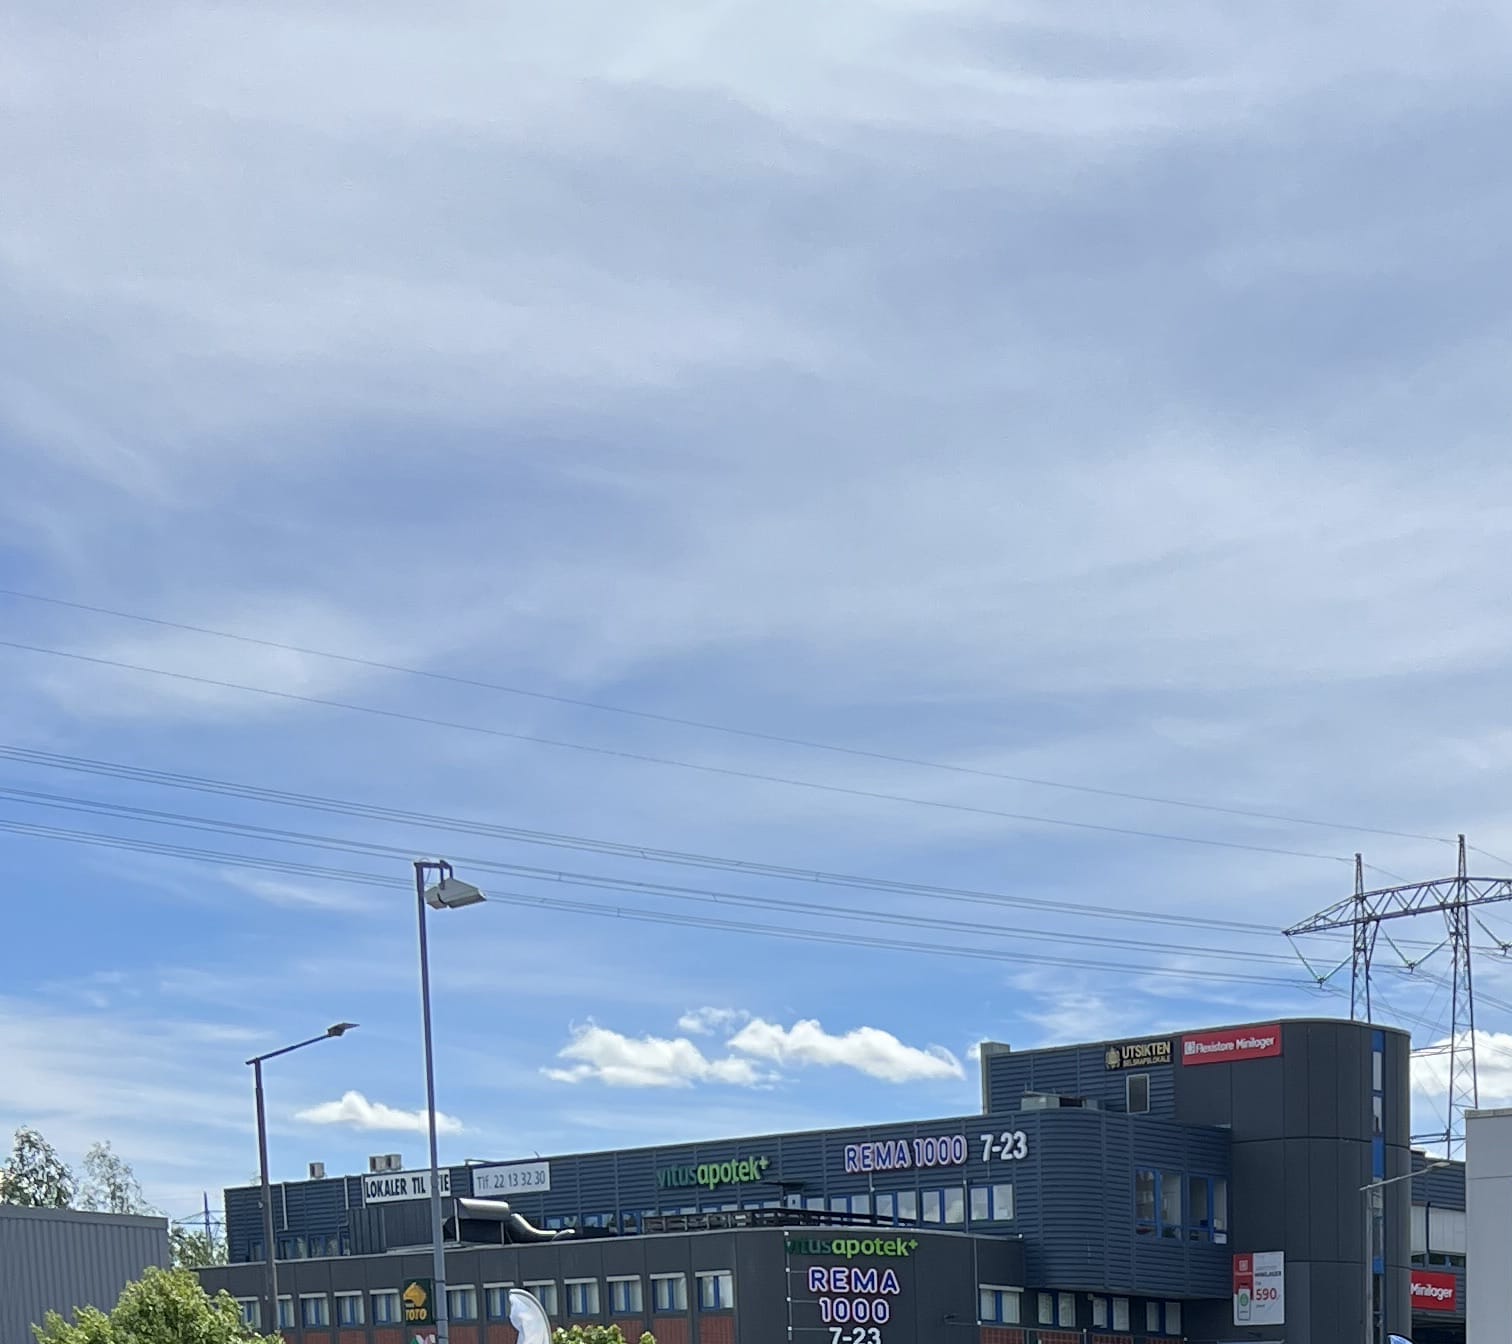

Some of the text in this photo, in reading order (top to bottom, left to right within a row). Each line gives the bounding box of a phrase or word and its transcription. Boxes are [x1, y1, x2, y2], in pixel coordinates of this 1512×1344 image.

[1121, 1041, 1171, 1060] UTSIKTEN
[845, 1130, 1028, 1173] REMA 1000 7-23
[366, 1177, 408, 1199] LOKALER
[412, 1176, 426, 1195] TIL
[494, 1174, 504, 1189] 22
[507, 1172, 518, 1188] 13
[521, 1171, 532, 1186] 32
[534, 1169, 546, 1185] 30
[808, 1266, 900, 1295] REMA
[1410, 1282, 1453, 1301] Minilager
[405, 1308, 427, 1321] TOTO
[819, 1296, 890, 1324] 1000
